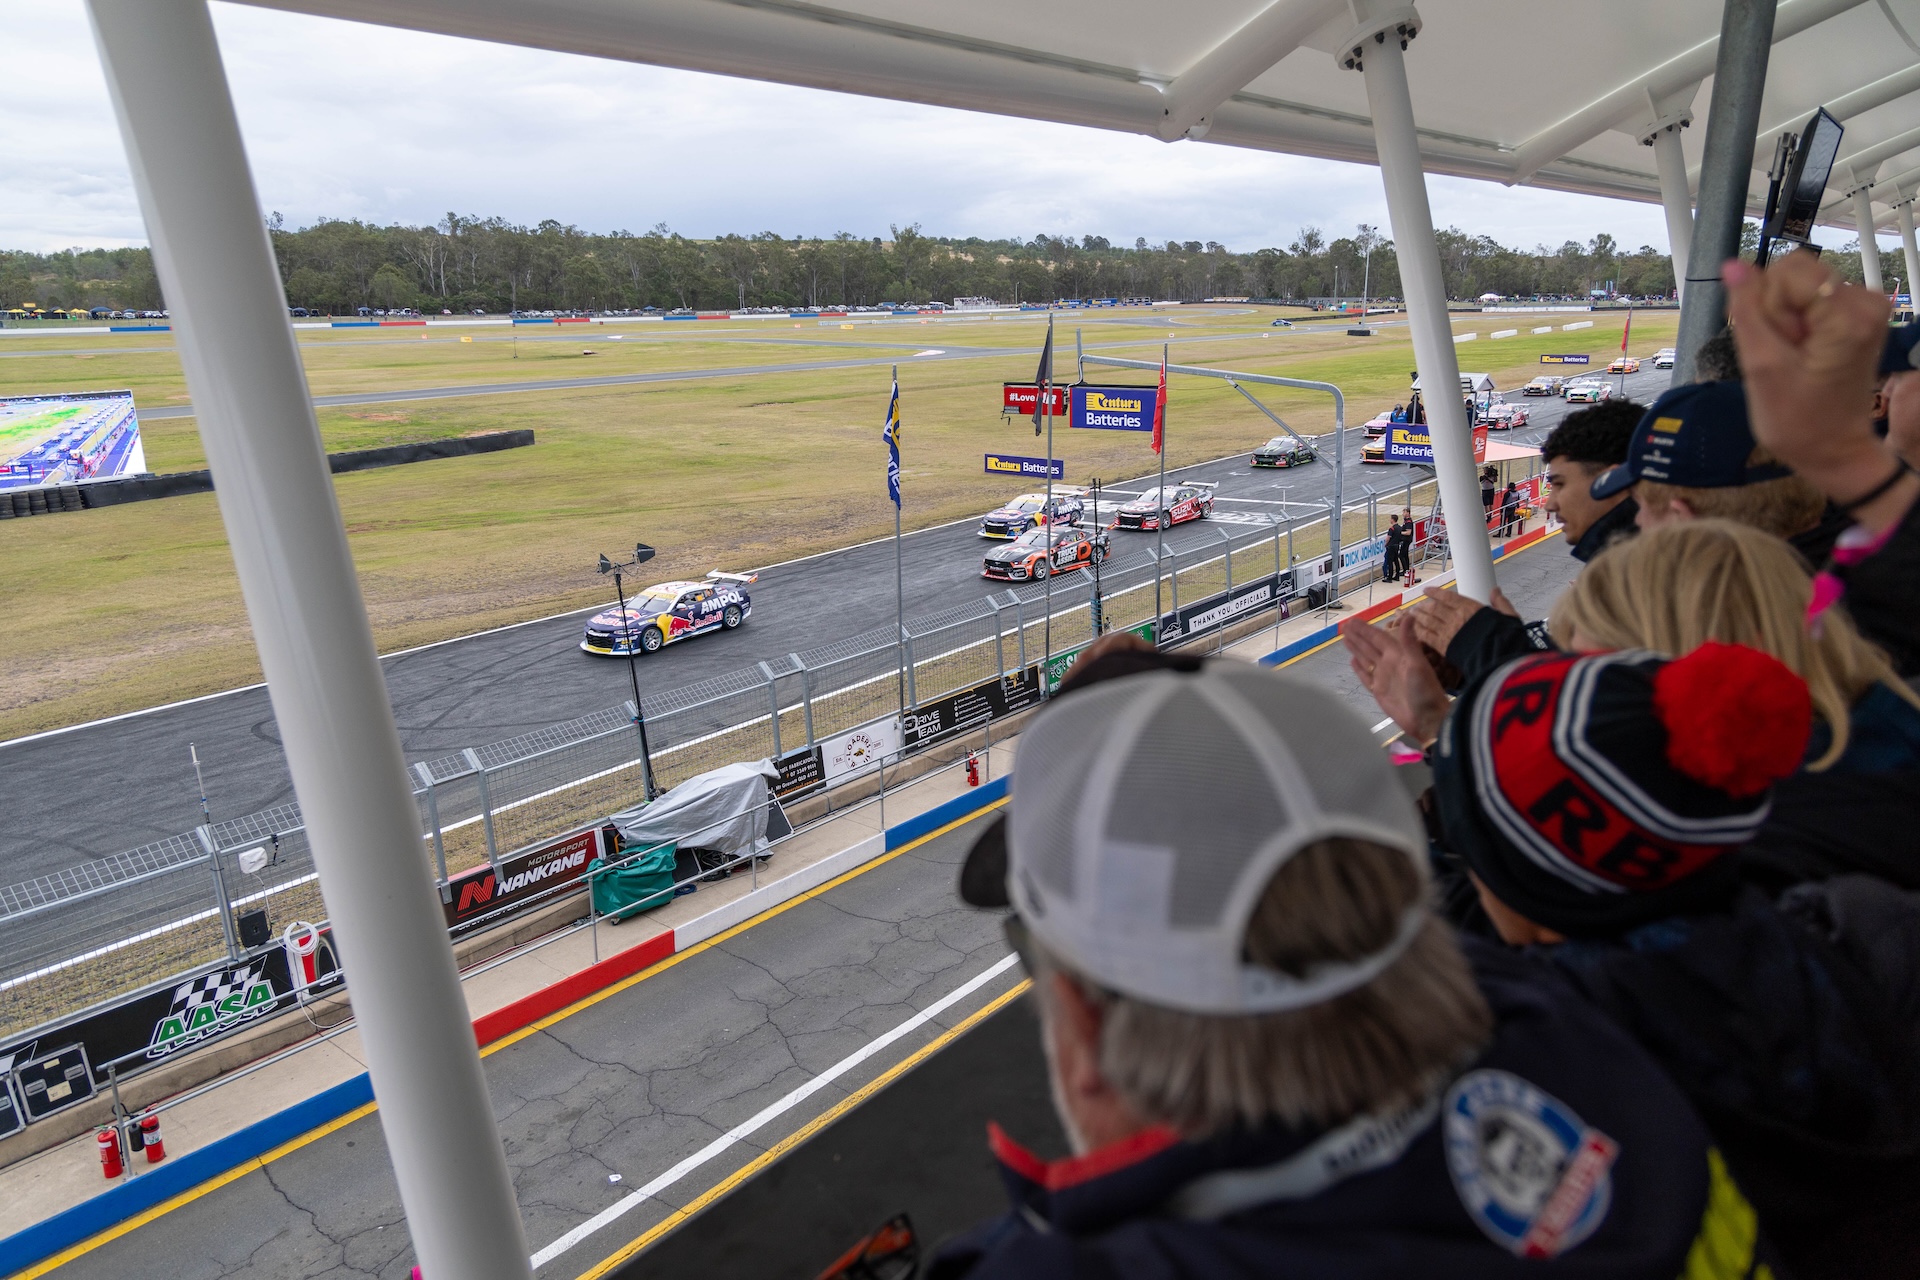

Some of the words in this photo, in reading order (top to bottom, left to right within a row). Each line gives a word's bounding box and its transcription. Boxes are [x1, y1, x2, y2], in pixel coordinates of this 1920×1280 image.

[1009, 392, 1035, 402] #Love
[1086, 392, 1141, 412] Century
[1086, 412, 1141, 427] Batteries
[1392, 429, 1432, 444] Centu
[1391, 444, 1433, 457] Batterie
[987, 457, 1020, 472] Century
[1022, 462, 1060, 475] Batteres
[1345, 549, 1360, 567] DICK
[1360, 540, 1386, 561] JOHNSO
[701, 591, 744, 615] AMPOL
[1193, 611, 1216, 628] THANK
[1235, 590, 1268, 610] OFFICIALS
[904, 709, 940, 736] DRIVE
[917, 722, 941, 739] TEAM
[527, 838, 589, 867] MOTORSPORT
[497, 849, 586, 896] NANKANG
[148, 980, 278, 1057] AASA
